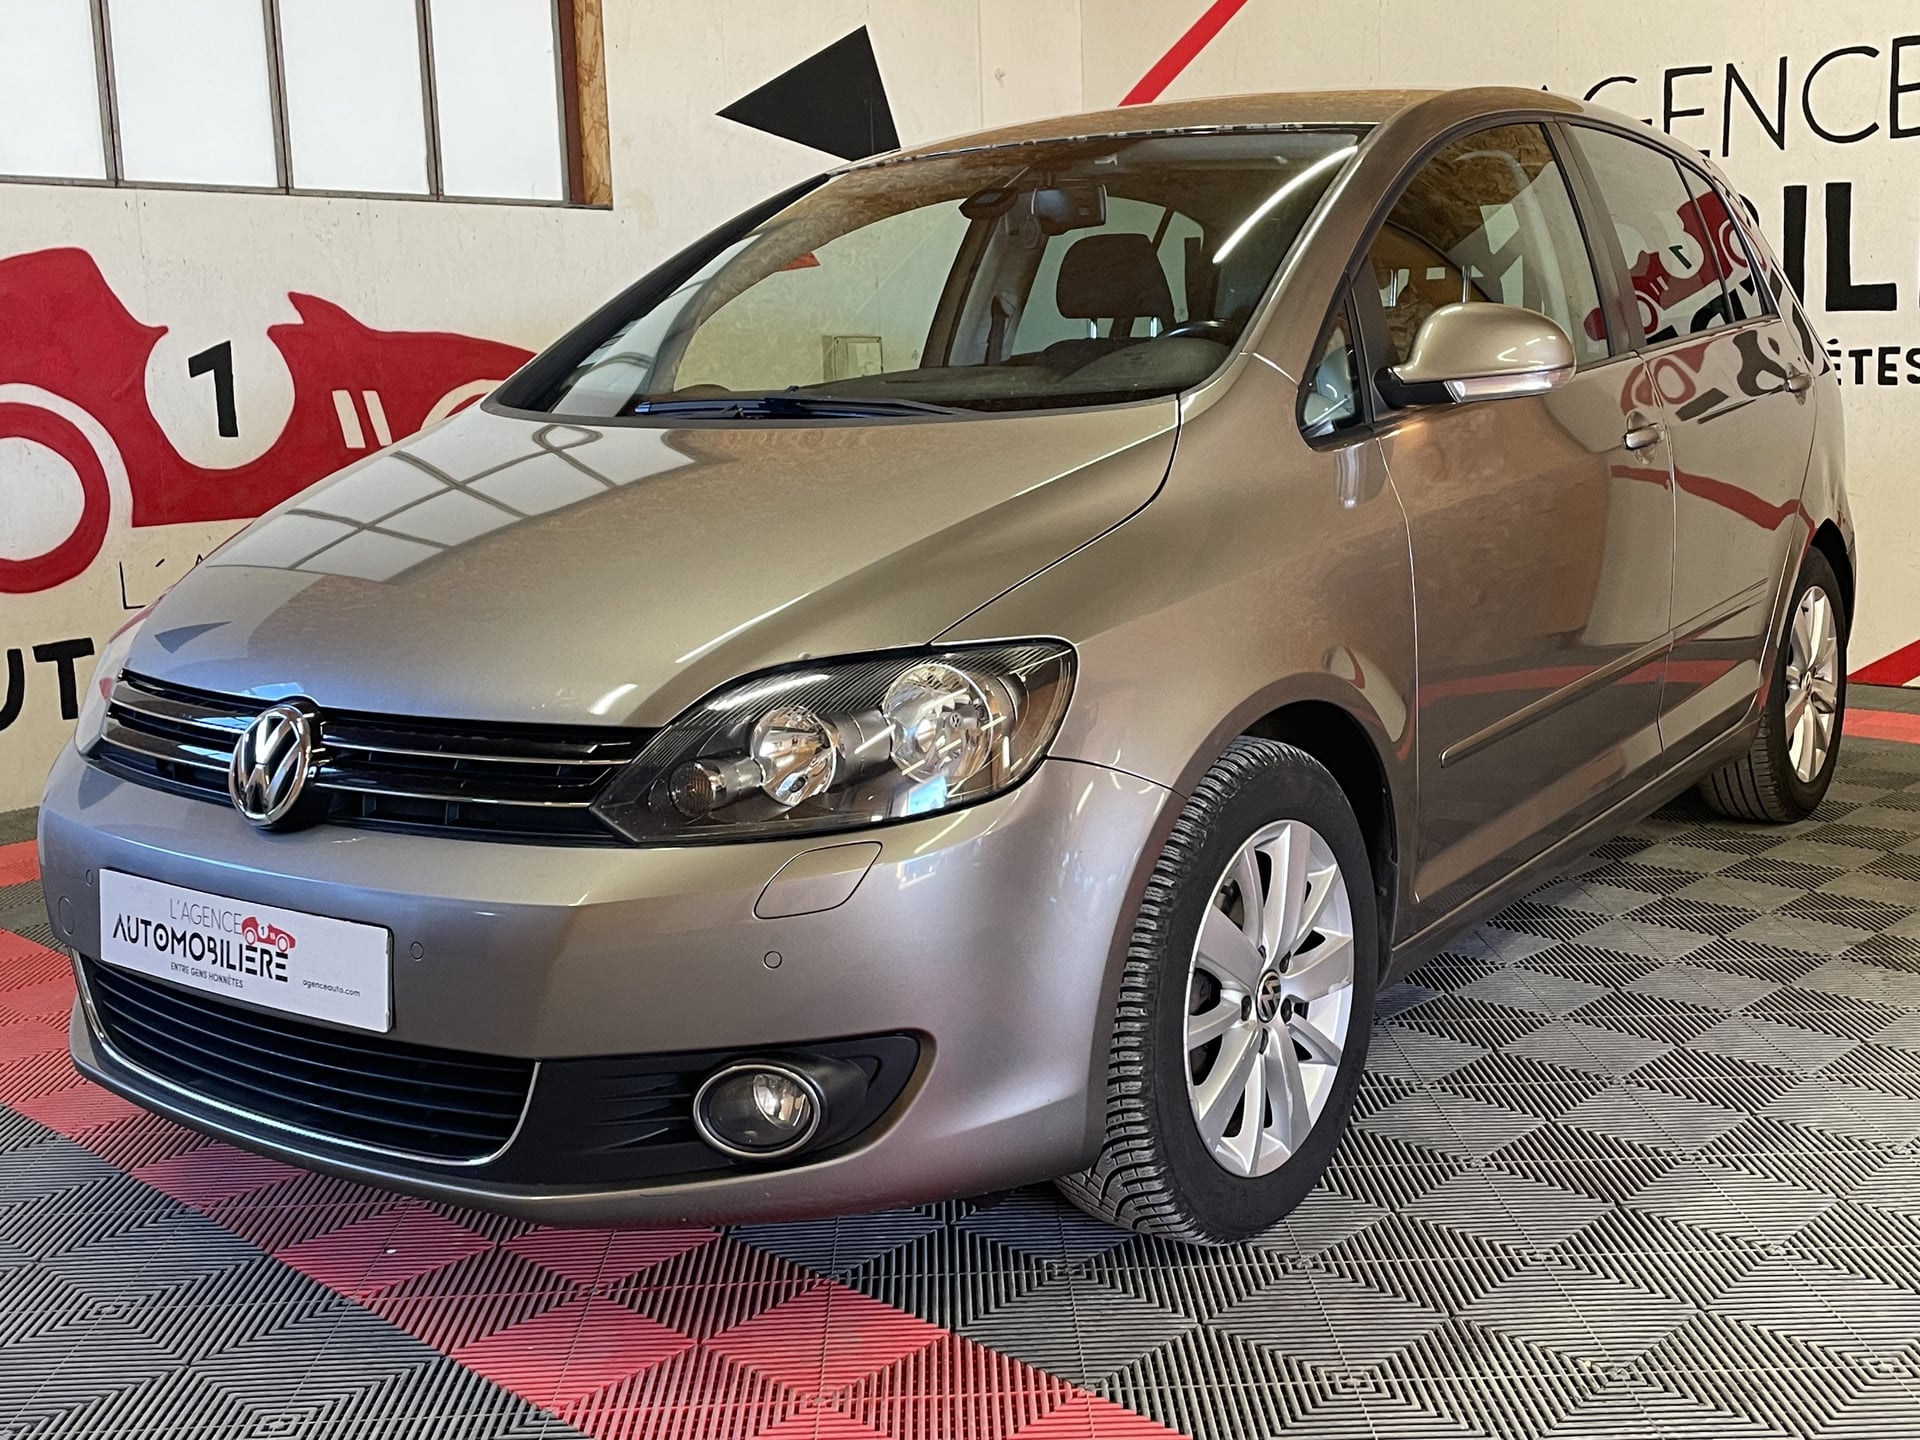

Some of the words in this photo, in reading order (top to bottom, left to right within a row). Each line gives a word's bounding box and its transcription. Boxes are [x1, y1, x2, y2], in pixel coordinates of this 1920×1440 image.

[1541, 35, 1920, 158] ENCE
[1739, 182, 1897, 312] IL
[187, 340, 239, 437] 1
[170, 897, 242, 935] L'AGENCE
[170, 961, 190, 975] ENTRE
[190, 967, 208, 980] GENS
[208, 972, 244, 989] HONNÊTES
[302, 979, 361, 997] agenceauto.com
